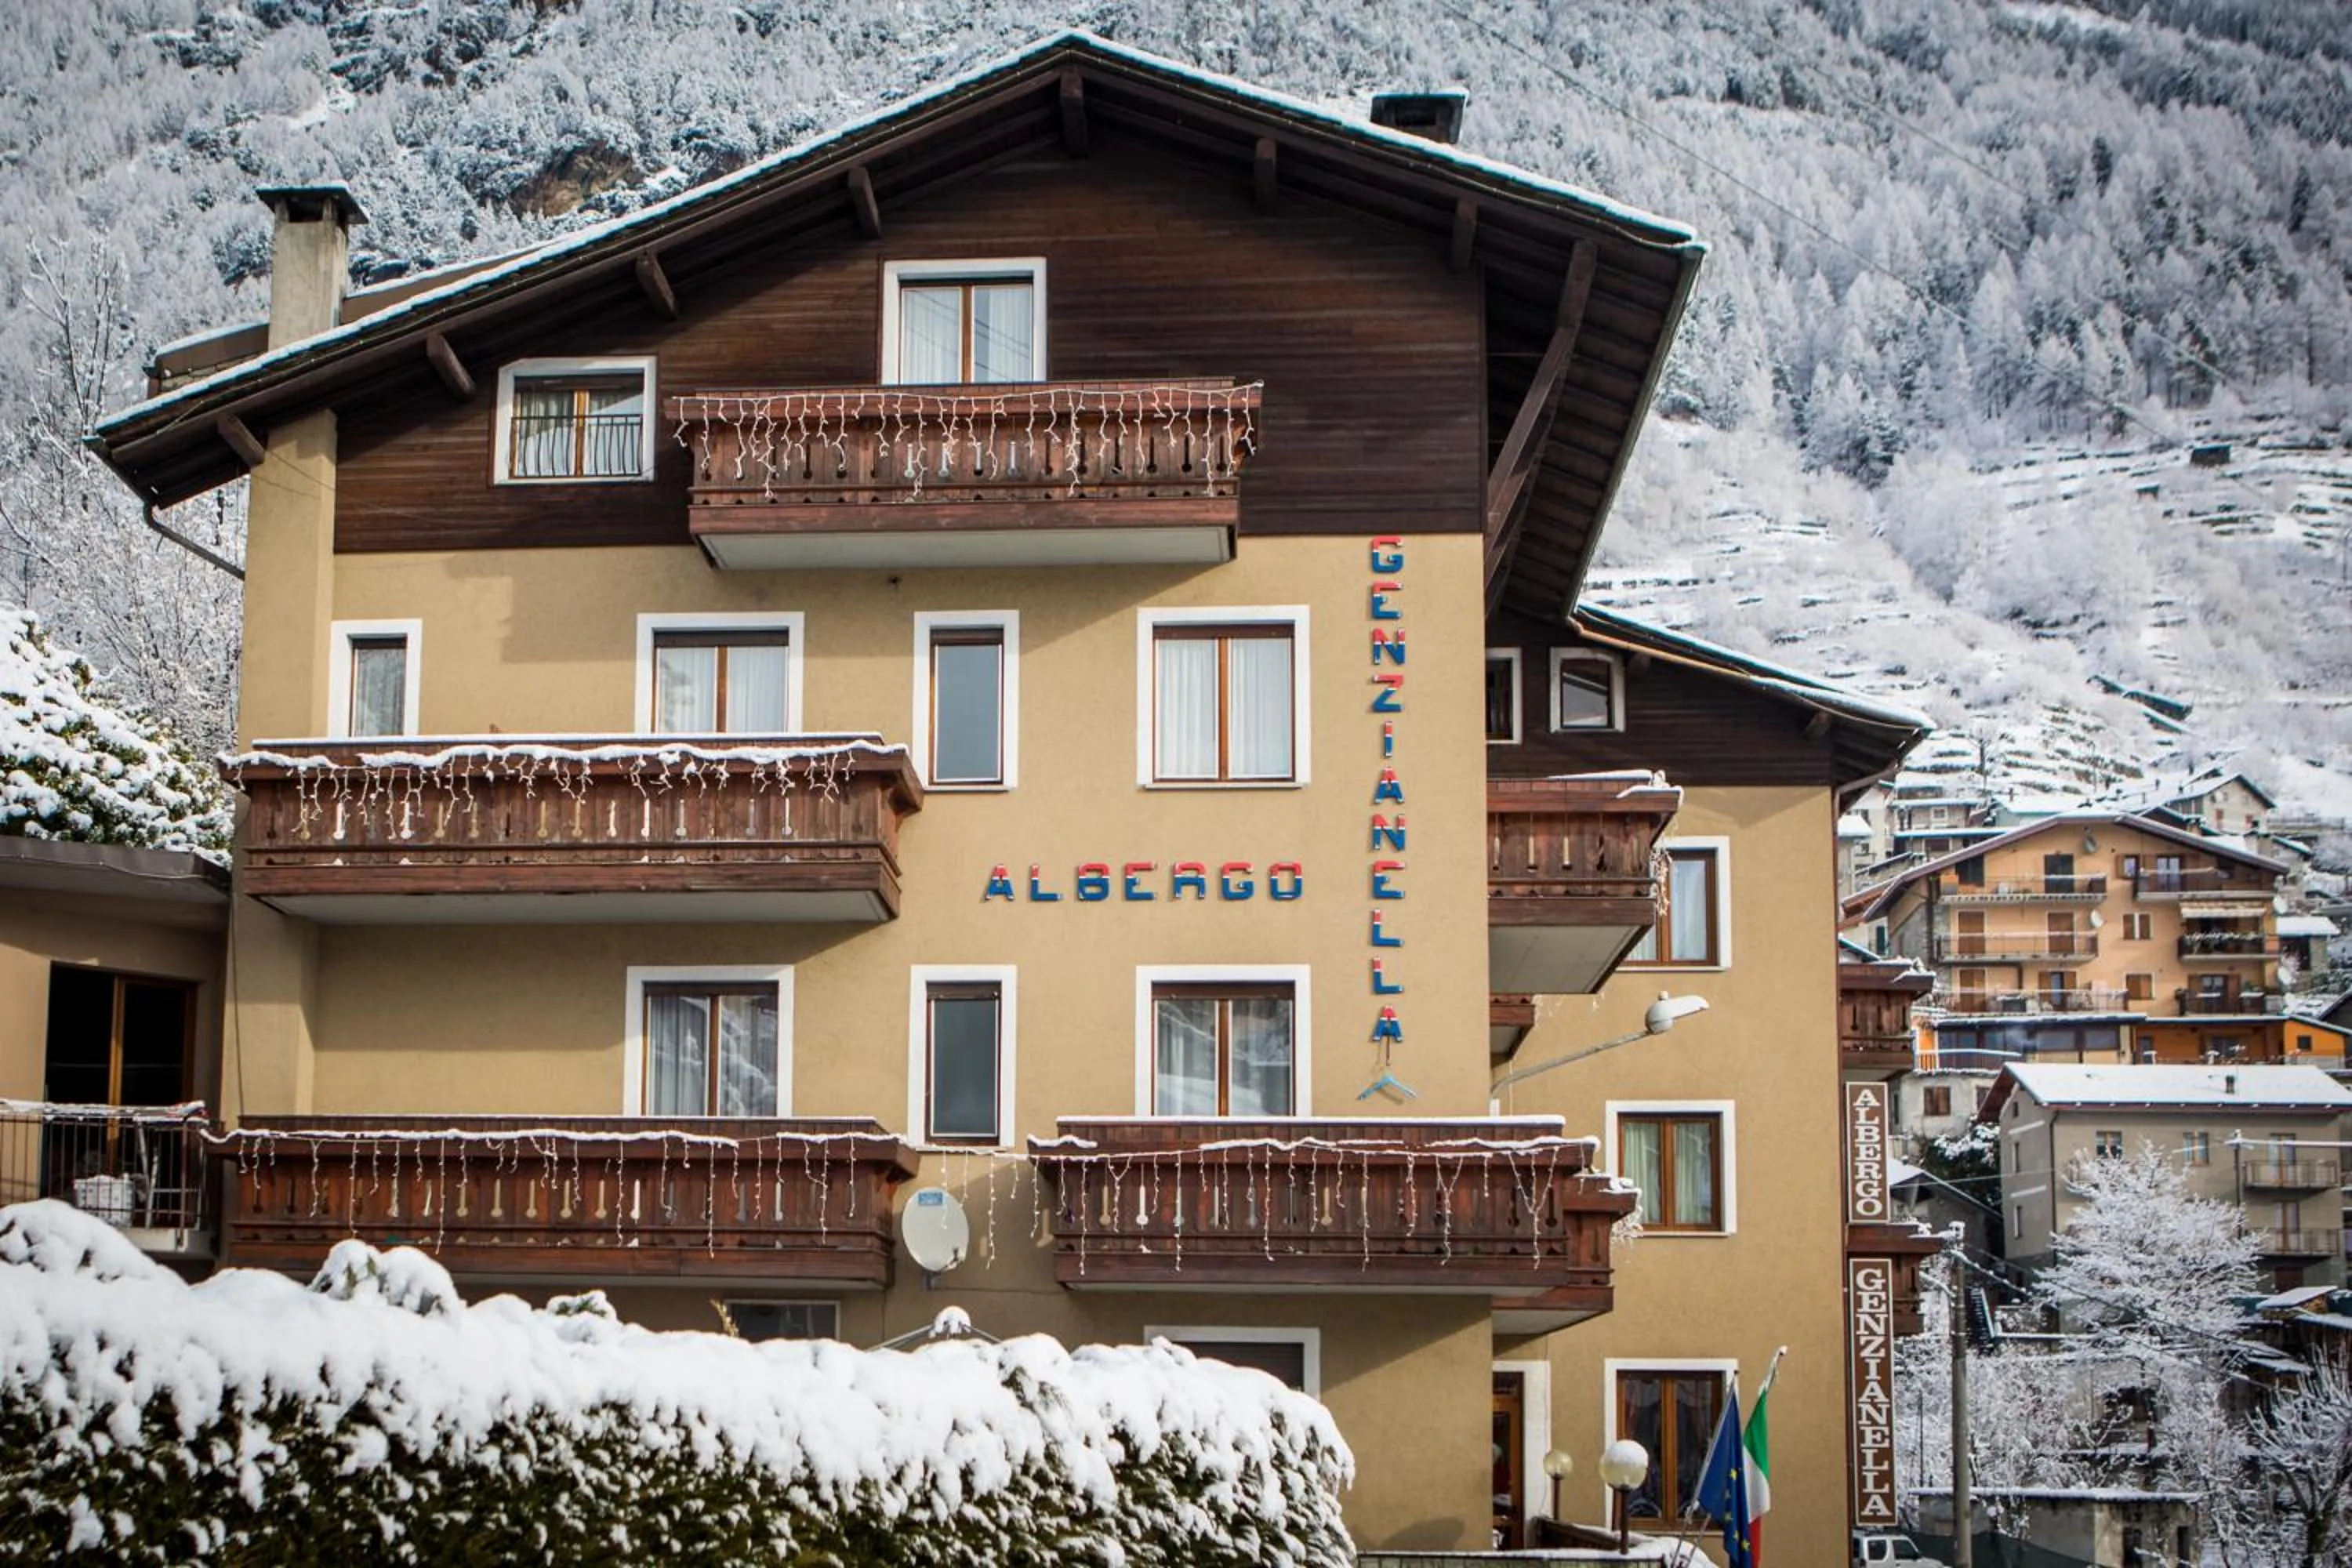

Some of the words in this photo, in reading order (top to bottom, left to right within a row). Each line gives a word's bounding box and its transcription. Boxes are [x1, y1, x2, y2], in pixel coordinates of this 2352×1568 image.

[984, 862, 1304, 902] ALBERGO
[1370, 535, 1406, 1044] GENZIANELLA
[1853, 1088, 1883, 1217] ALBERGO
[1856, 1269, 1891, 1516] GENZIANELLA
